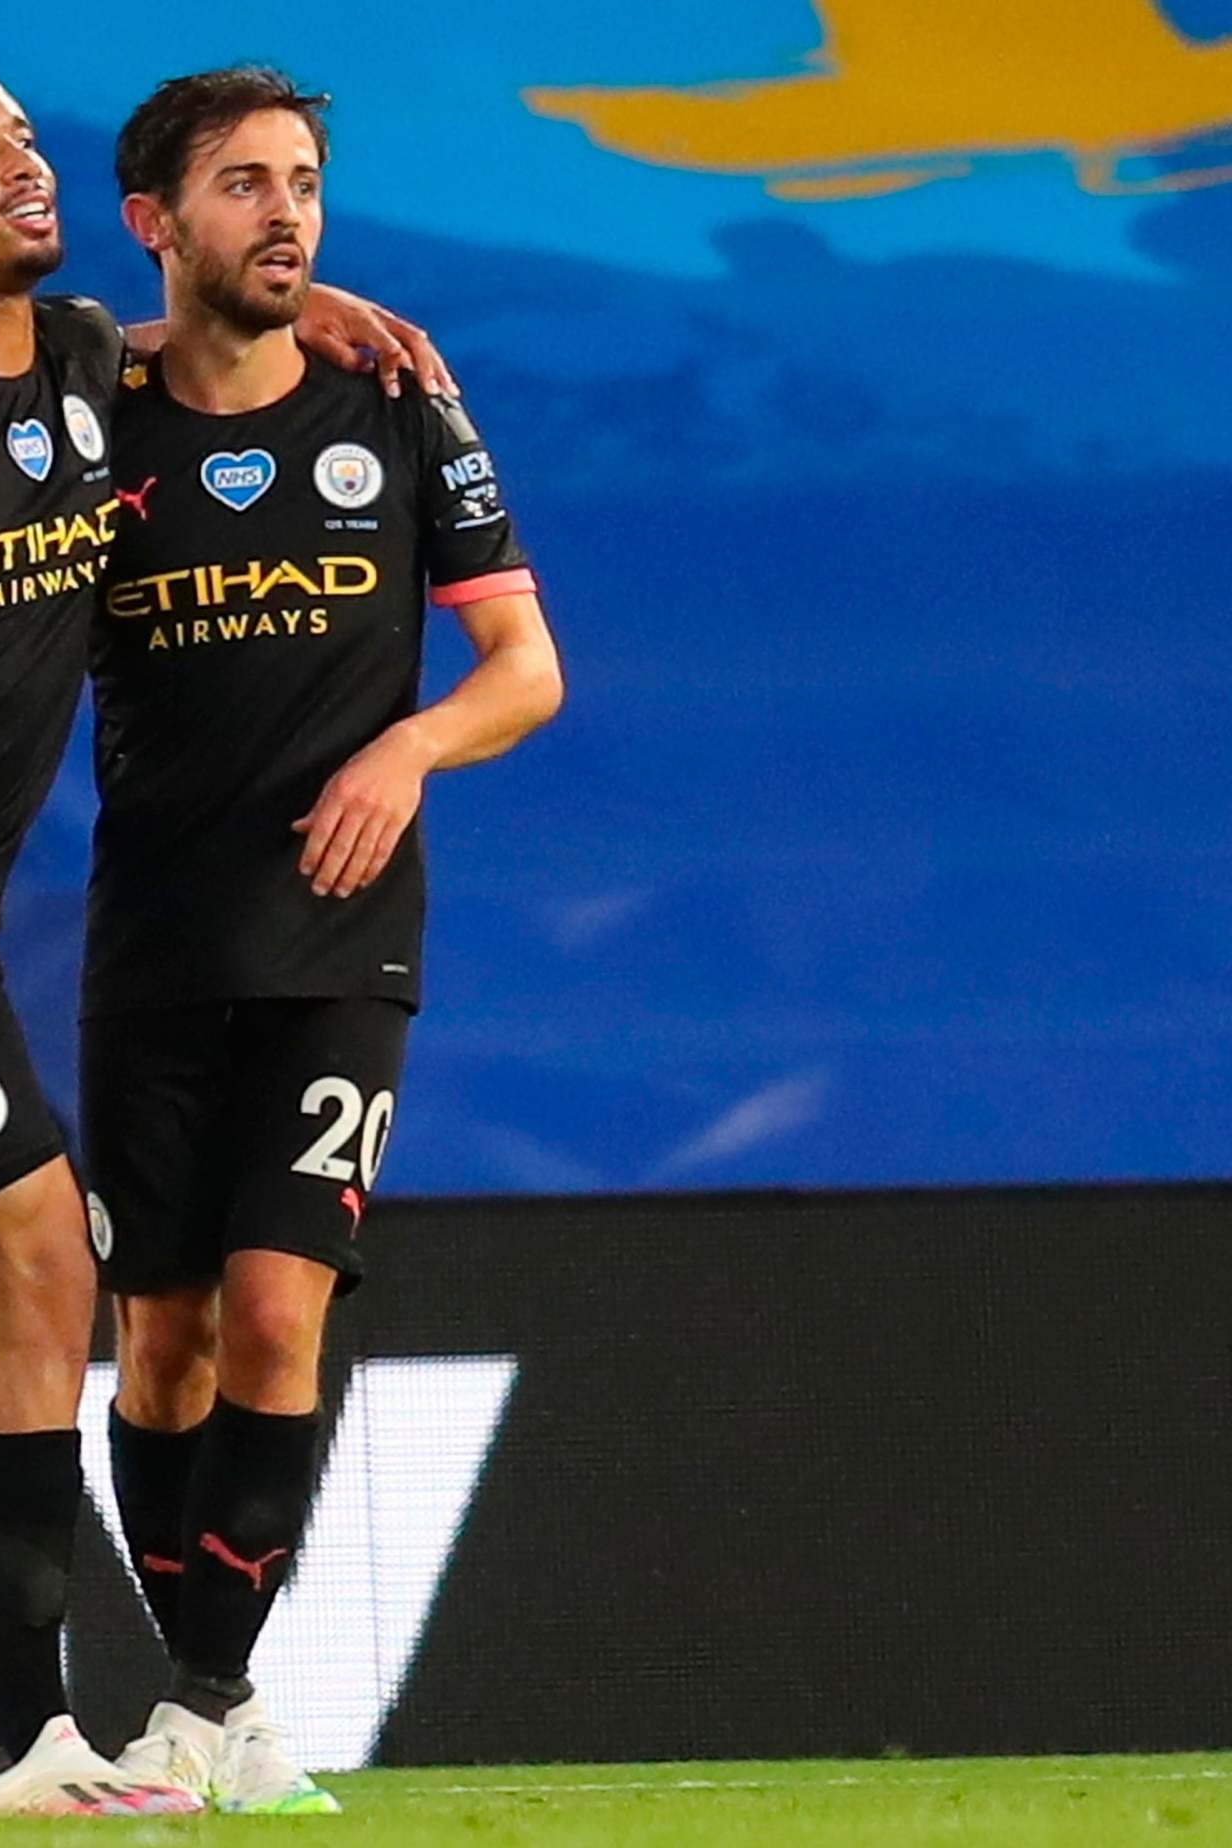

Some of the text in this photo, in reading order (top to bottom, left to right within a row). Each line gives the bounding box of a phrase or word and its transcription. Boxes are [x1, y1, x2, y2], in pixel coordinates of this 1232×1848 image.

[217, 467, 258, 486] NHS
[107, 556, 377, 618] ETIHAD
[149, 608, 328, 651] AIRWAYS
[290, 1076, 394, 1192] 20
